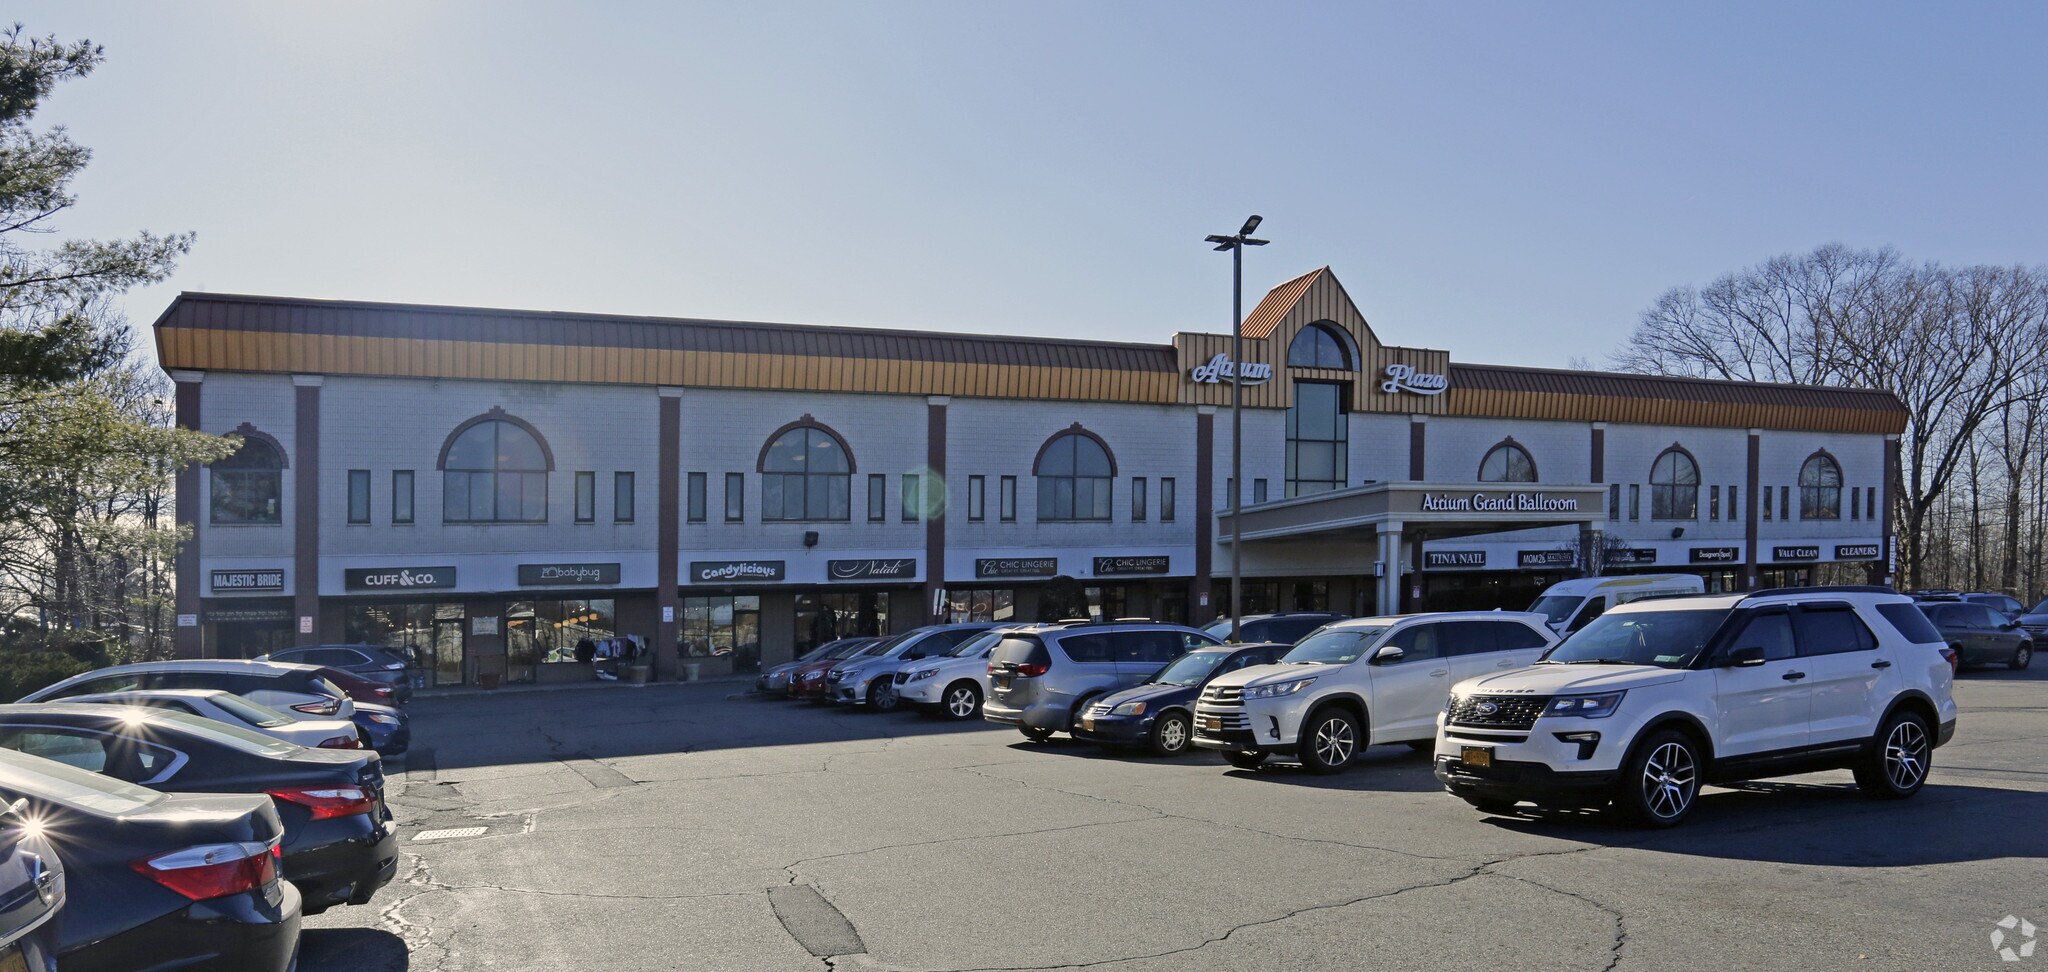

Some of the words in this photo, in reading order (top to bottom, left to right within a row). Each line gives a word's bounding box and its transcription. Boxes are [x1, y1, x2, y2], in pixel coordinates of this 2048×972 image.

[1192, 353, 1272, 386] Atrum
[1381, 364, 1448, 394] Plaza
[1423, 493, 1470, 511] Atrium
[1473, 493, 1515, 511] Grand
[1518, 492, 1577, 511] Ballroom
[1430, 553, 1457, 564] TINA
[1459, 553, 1485, 564] NAIL
[1840, 546, 1877, 556] CLEANERS
[858, 560, 906, 577] Natali
[1000, 561, 1020, 569] CHIC
[1021, 560, 1055, 569] LINGERIE
[1116, 559, 1135, 567] CHIC
[1136, 558, 1167, 566] LINGERIE
[557, 566, 600, 582] babybug
[701, 563, 776, 580] Candylicious
[213, 573, 255, 587] MAJESTIC
[257, 573, 282, 586] BRIDE
